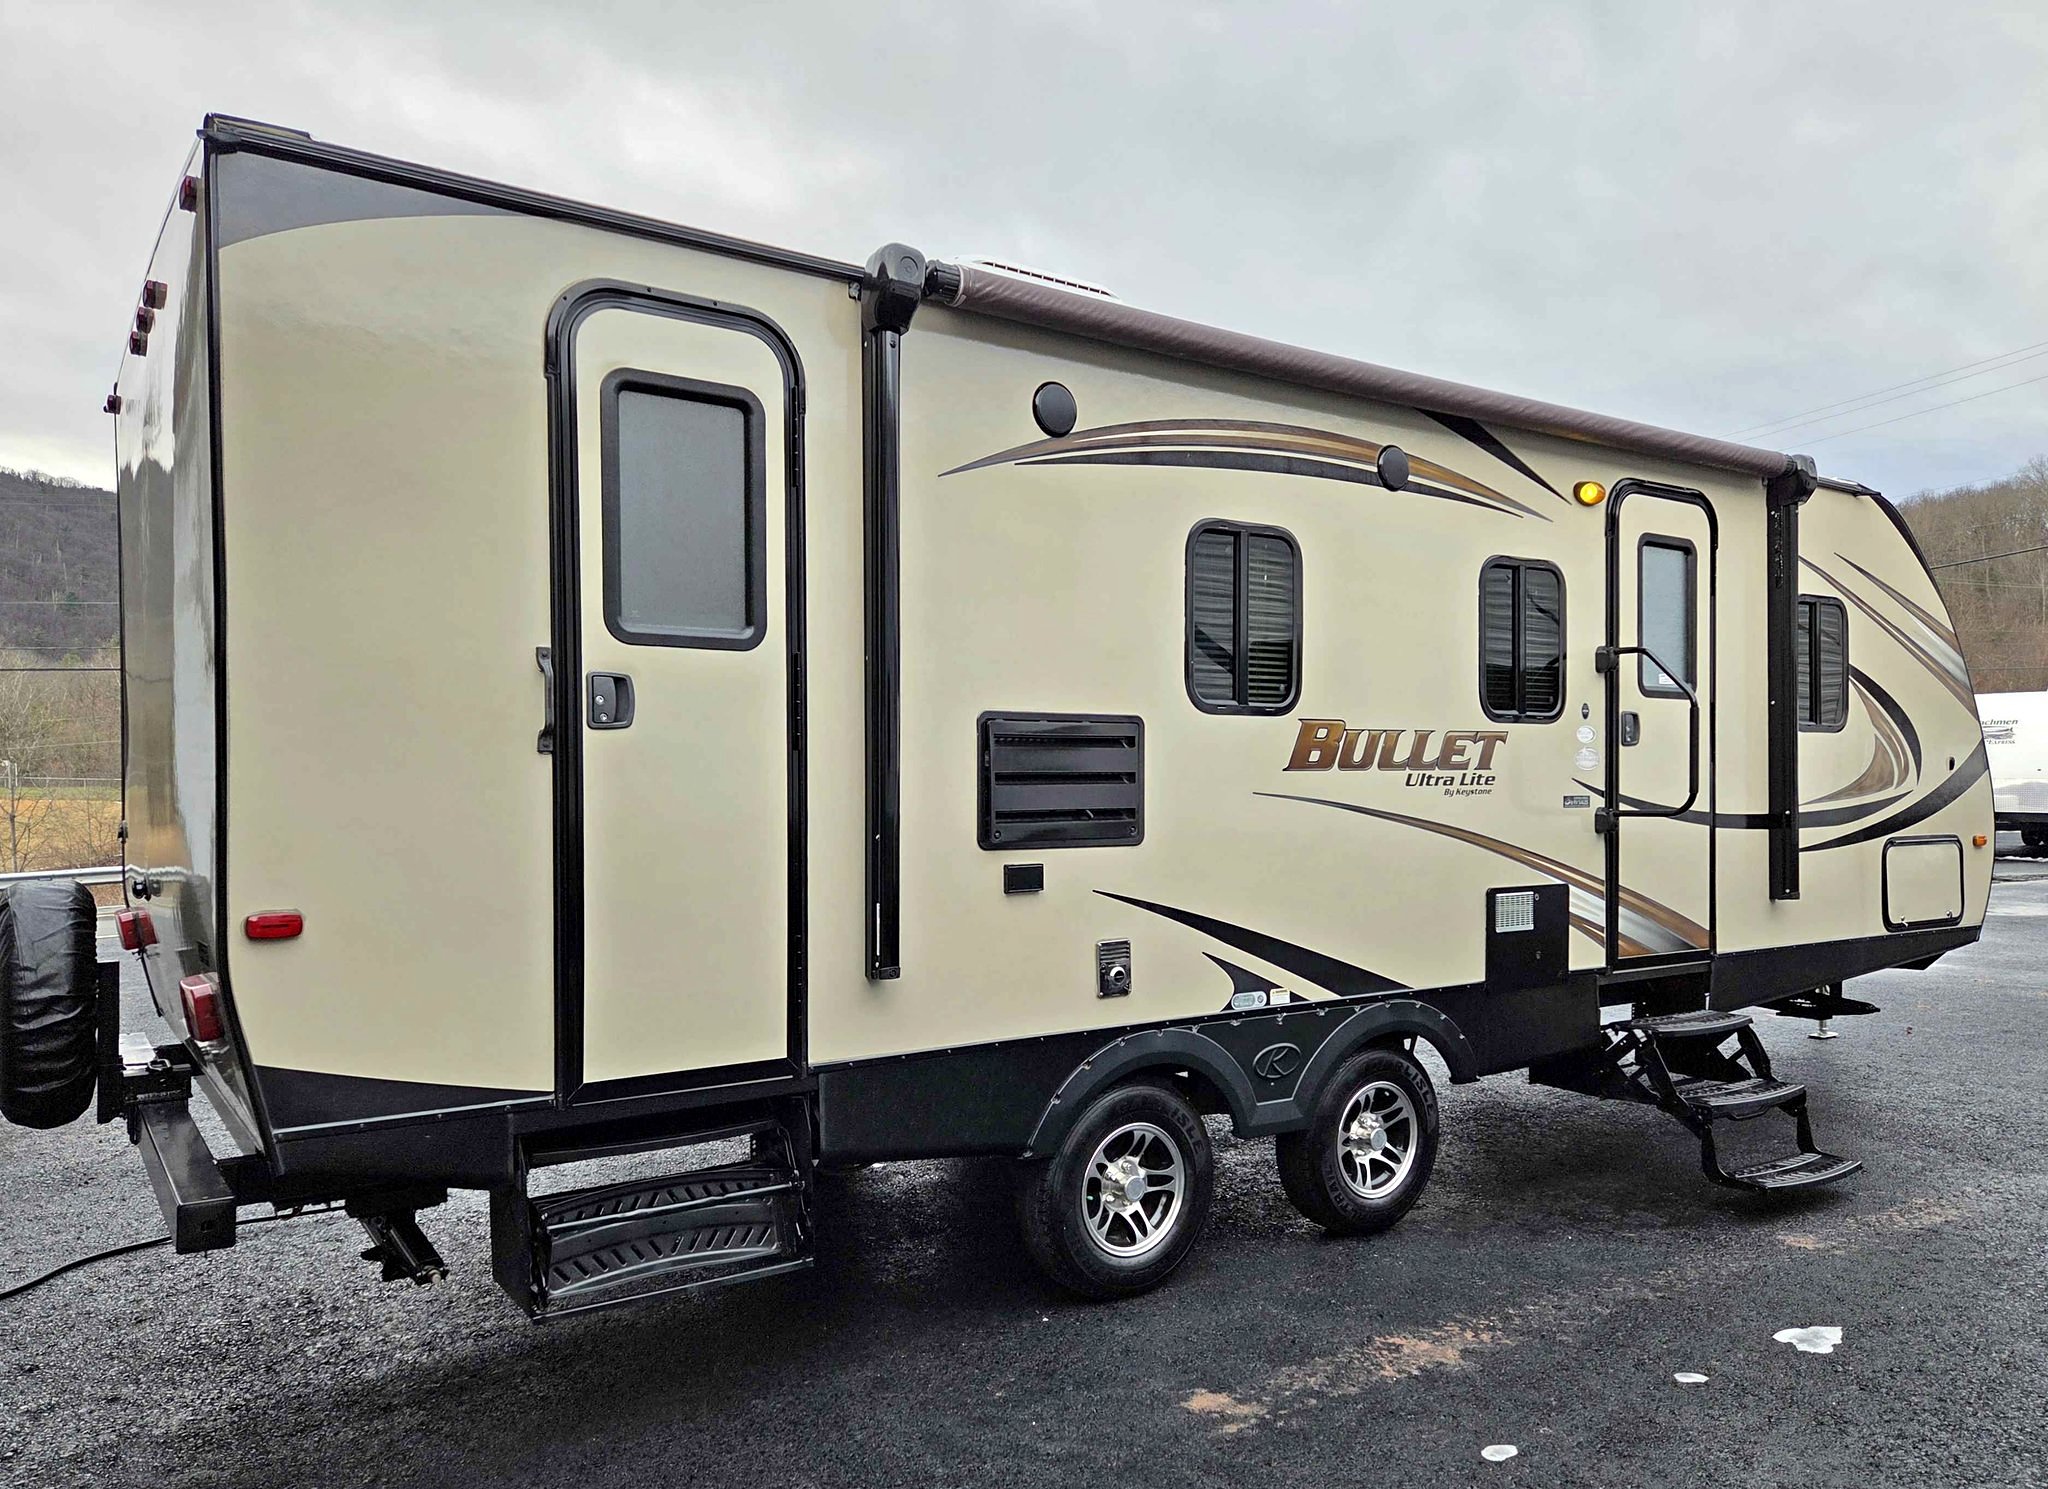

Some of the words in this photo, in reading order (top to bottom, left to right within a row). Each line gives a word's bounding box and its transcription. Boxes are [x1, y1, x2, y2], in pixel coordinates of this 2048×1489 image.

[1282, 718, 1509, 772] BULLET
[1405, 773, 1455, 787] Ultra
[1459, 772, 1496, 787] Lite
[1444, 788, 1455, 797] By
[1456, 787, 1493, 797] Keystone
